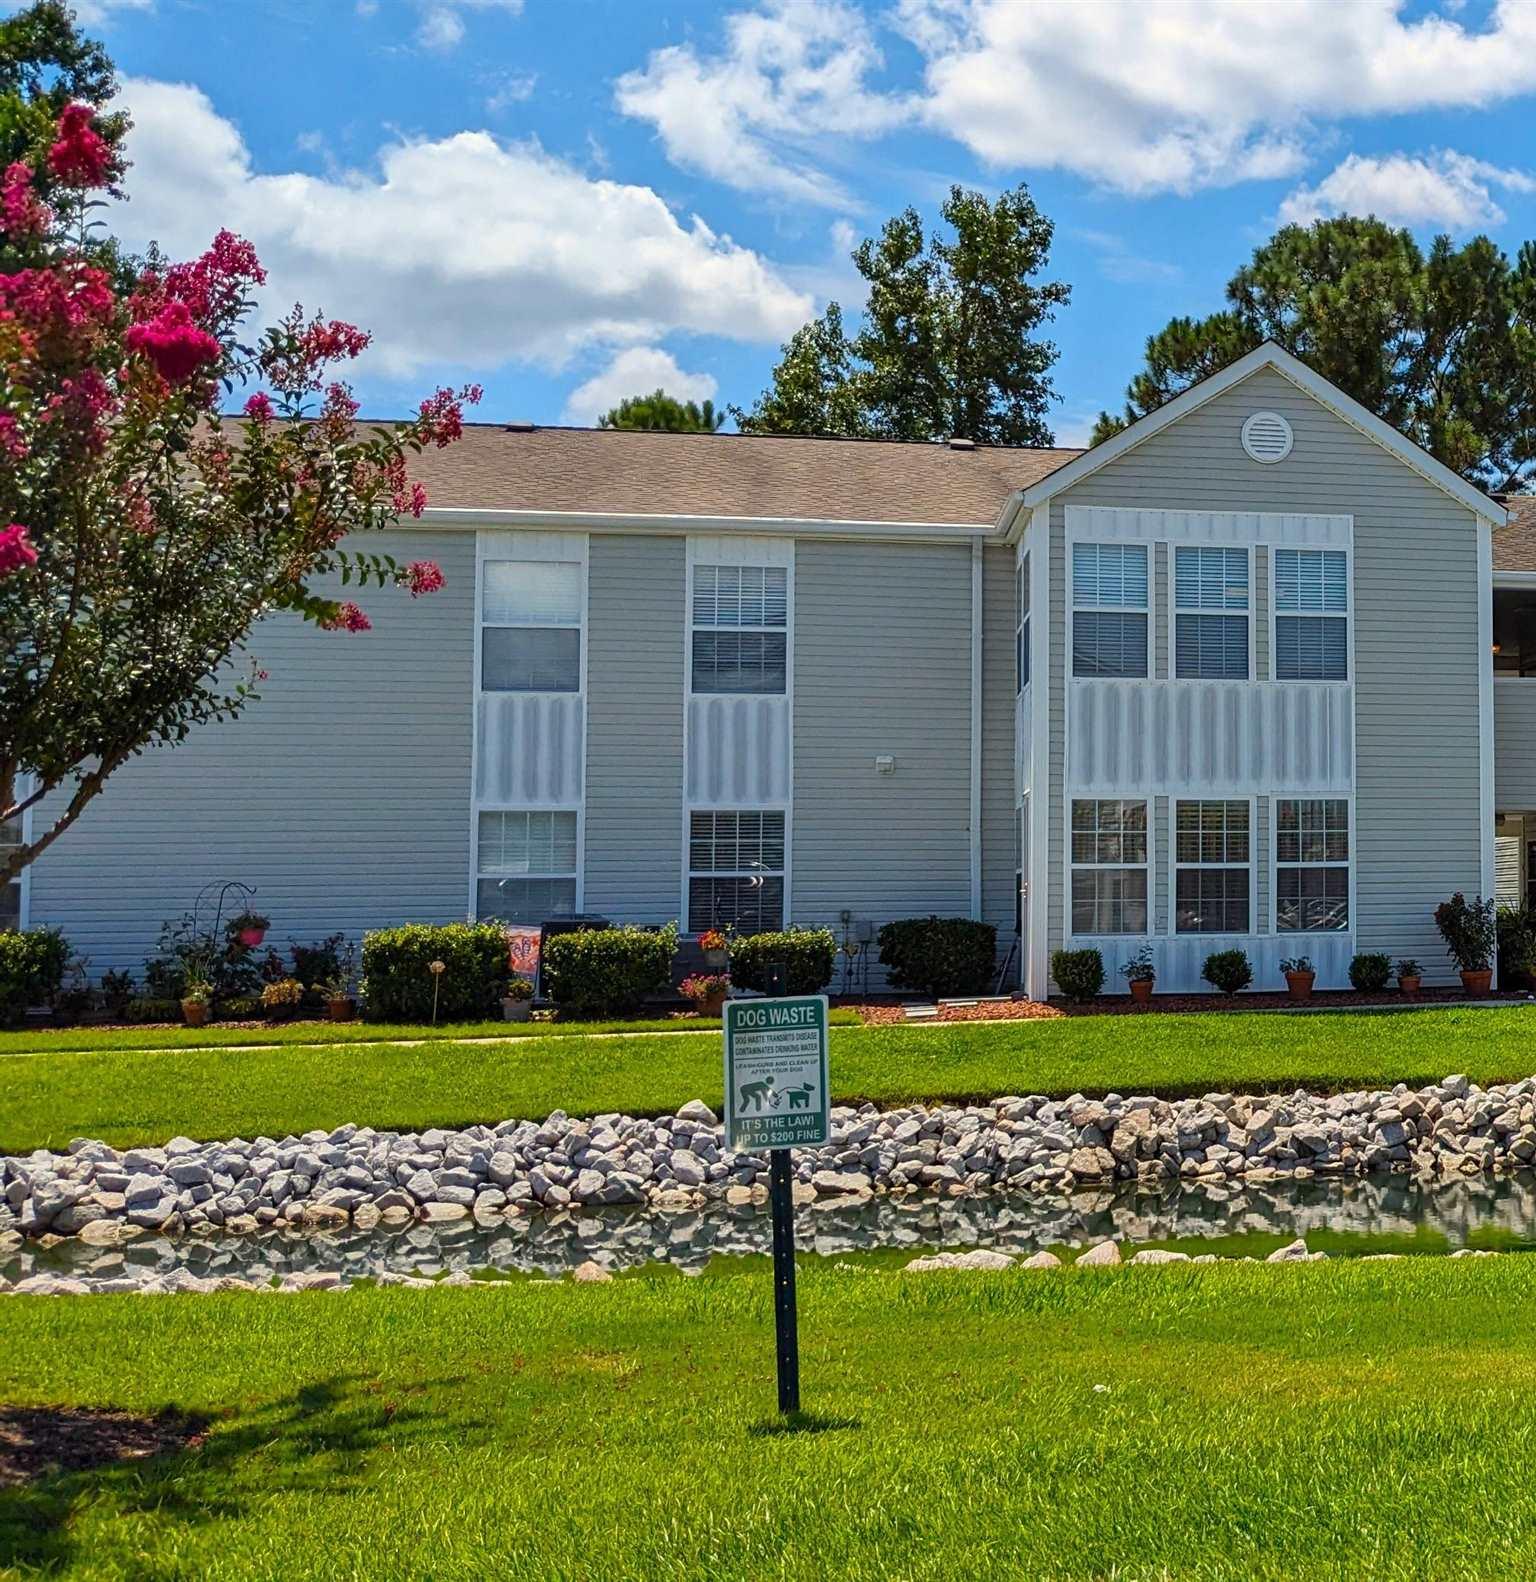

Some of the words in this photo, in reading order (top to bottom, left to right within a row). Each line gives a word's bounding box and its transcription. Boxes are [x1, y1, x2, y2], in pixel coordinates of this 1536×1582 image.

[737, 1009, 767, 1026] DOG
[769, 1006, 815, 1025] WASTE
[735, 1035, 747, 1045] DOG
[796, 1031, 817, 1040] DISEASE
[735, 1045, 774, 1056] CONTAMINATES
[801, 1042, 818, 1051] WATER
[742, 1119, 761, 1131] IT'S
[765, 1117, 785, 1128] THE
[788, 1115, 815, 1127] LAW!
[736, 1133, 751, 1145] UP
[753, 1132, 769, 1143] TO
[770, 1131, 794, 1143] $200
[796, 1129, 821, 1140] FINE
